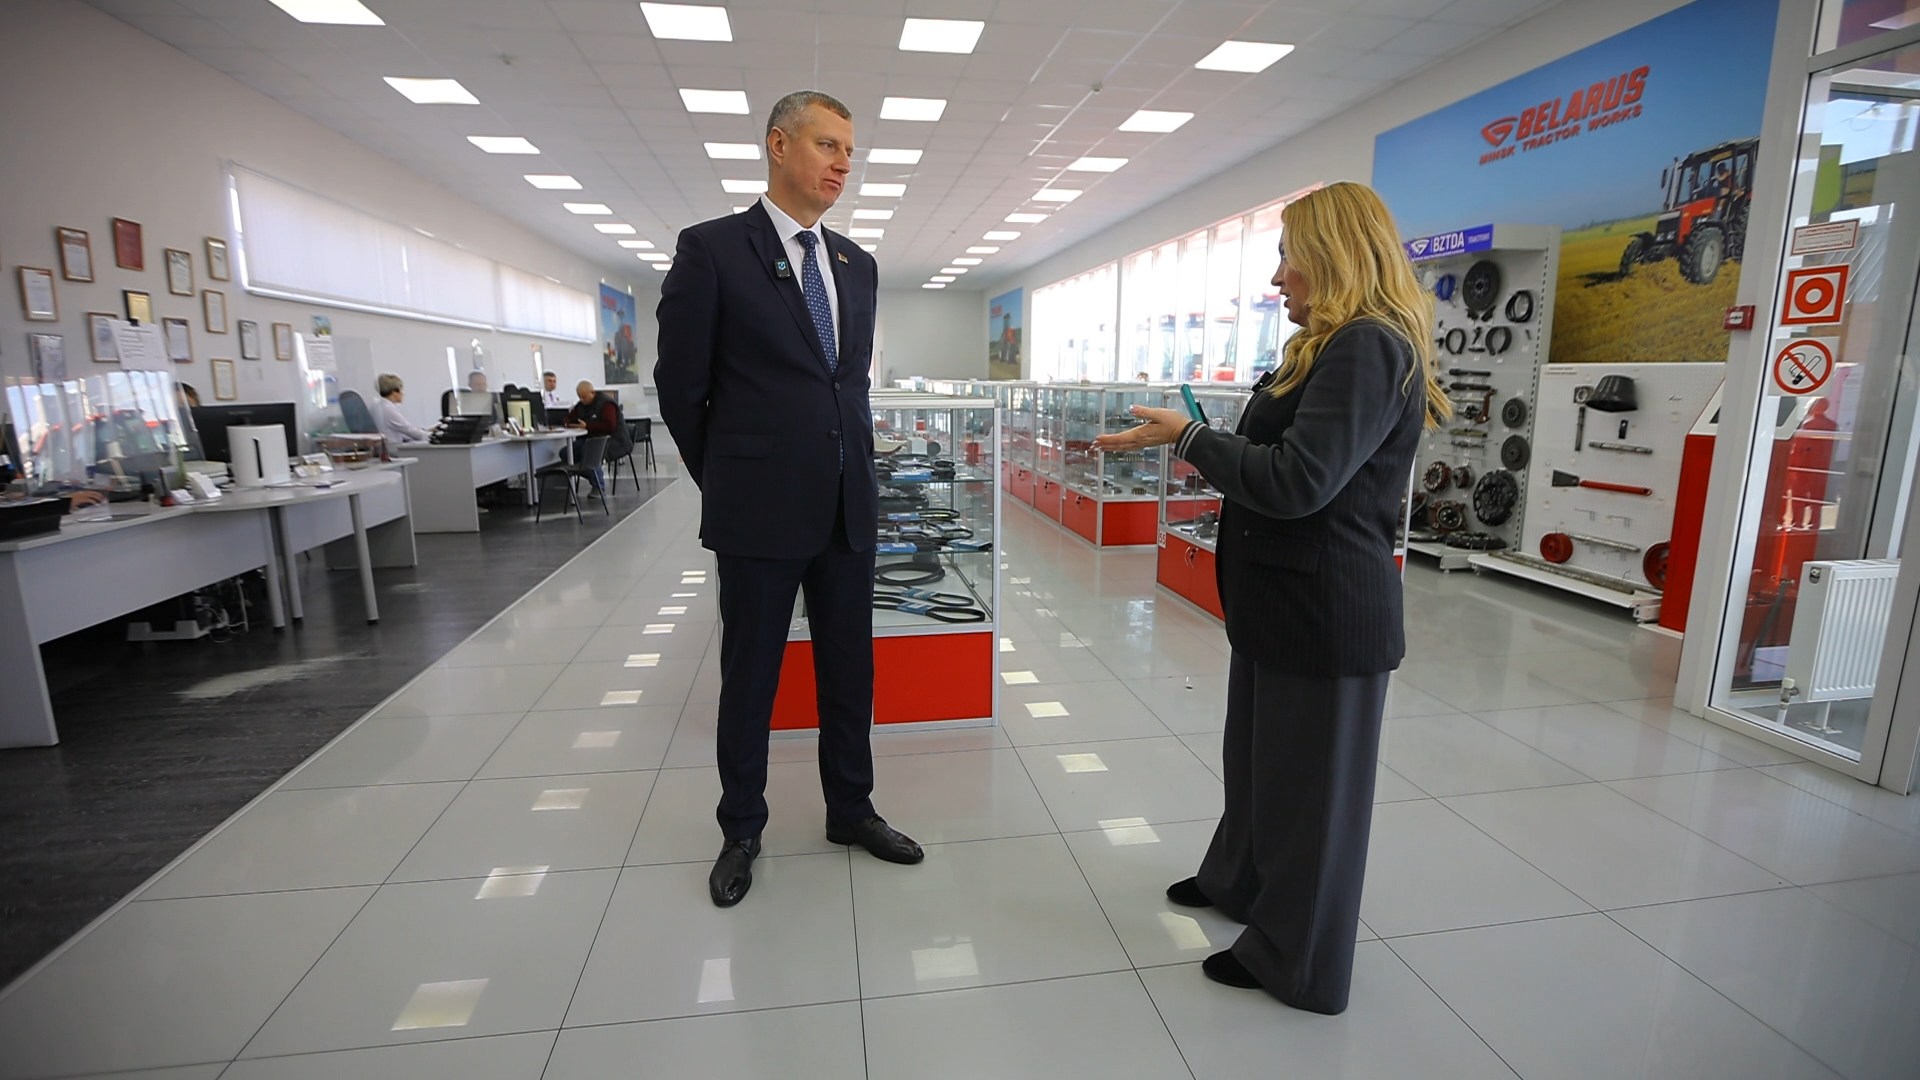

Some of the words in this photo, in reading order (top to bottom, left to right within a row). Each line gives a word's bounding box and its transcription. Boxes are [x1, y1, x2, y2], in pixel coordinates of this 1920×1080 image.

[1516, 65, 1650, 141] BELARUS
[1479, 146, 1515, 165] MINSK
[1523, 124, 1581, 152] TRACTOR
[1588, 104, 1643, 132] WORKS
[1433, 231, 1465, 252] BZTDA
